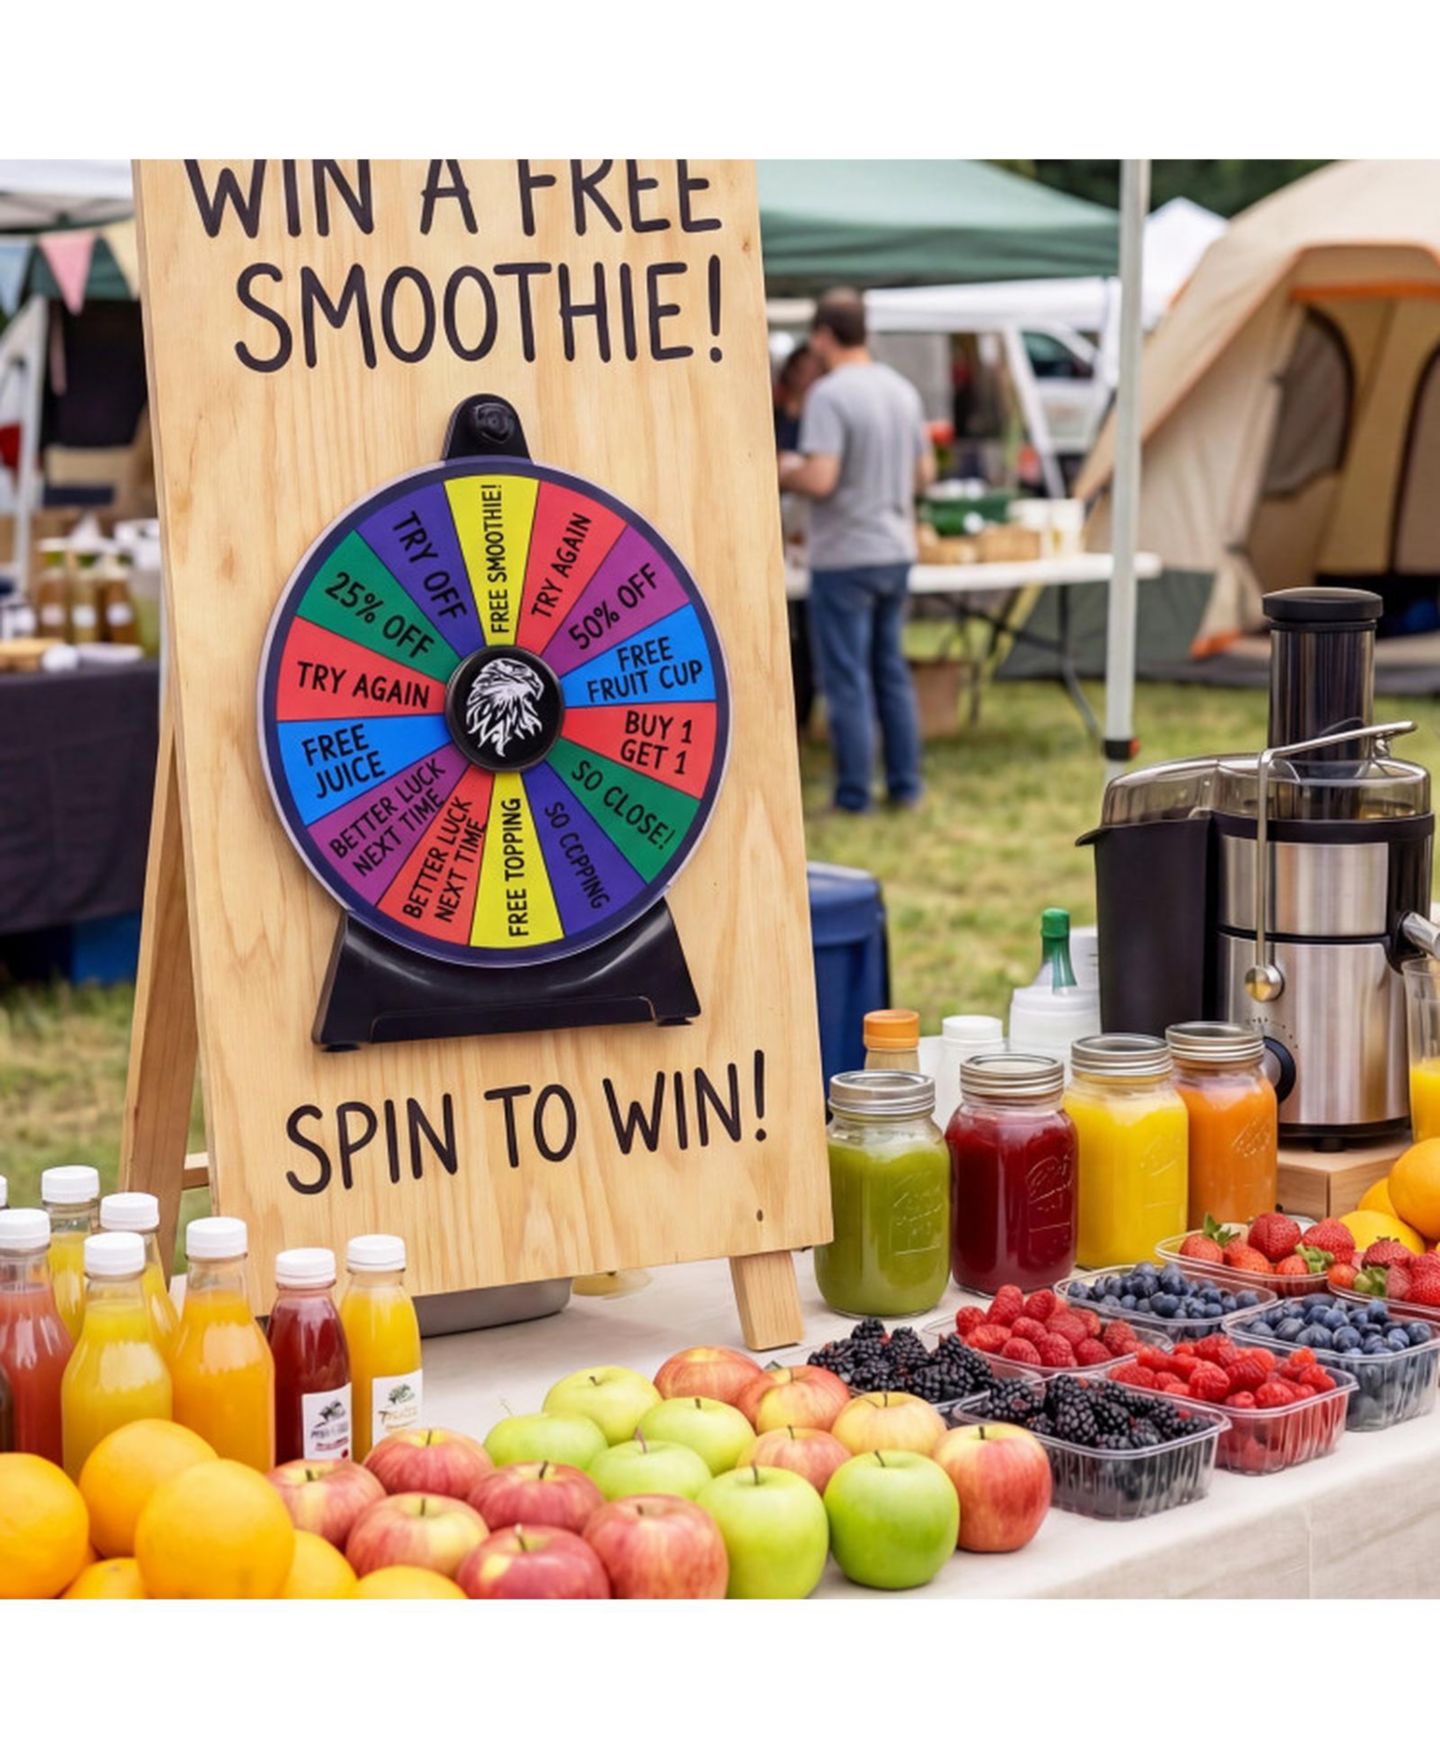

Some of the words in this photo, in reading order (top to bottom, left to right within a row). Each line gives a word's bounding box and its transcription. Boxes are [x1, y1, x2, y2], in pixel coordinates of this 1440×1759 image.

[185, 159, 373, 238] WIN
[419, 159, 479, 236] A
[516, 159, 722, 236] FREE
[234, 255, 723, 373] SMOOTHIE!
[393, 510, 438, 563] TRY
[423, 572, 467, 619] OFF
[481, 484, 508, 583] SMOOTHIE!
[531, 578, 563, 617] TRY
[551, 512, 592, 578] AGAIN
[324, 572, 384, 624] 25%
[383, 615, 435, 658] OFF
[491, 589, 509, 634] FREE
[568, 601, 620, 650] 50%
[617, 563, 657, 609] OFF
[297, 661, 347, 694] TRY
[352, 673, 429, 708] AGAIN
[587, 670, 648, 703] FRUIT
[659, 660, 703, 689] CUP
[617, 637, 673, 671] FREE
[302, 723, 369, 766] FREE
[620, 739, 669, 769] GET
[674, 751, 686, 775] 1
[624, 710, 673, 740] BUY
[681, 719, 693, 744] 1
[315, 751, 386, 799] JUICE
[330, 796, 398, 859] BETTER
[395, 758, 446, 797] LUCK
[545, 802, 570, 829] SO
[571, 760, 604, 792] SO
[603, 786, 676, 850] CLOSE!
[353, 826, 402, 877] NEXT
[398, 788, 444, 832] TIME
[402, 846, 449, 919] BETTER
[437, 796, 472, 846] LUCK
[434, 868, 468, 923] NEXT
[455, 818, 487, 863] TIME
[501, 798, 524, 881] TOPPING
[506, 888, 529, 937] FREE
[286, 1093, 458, 1195] SPIN
[484, 1084, 577, 1168] TO
[602, 1049, 767, 1155] WIN!
